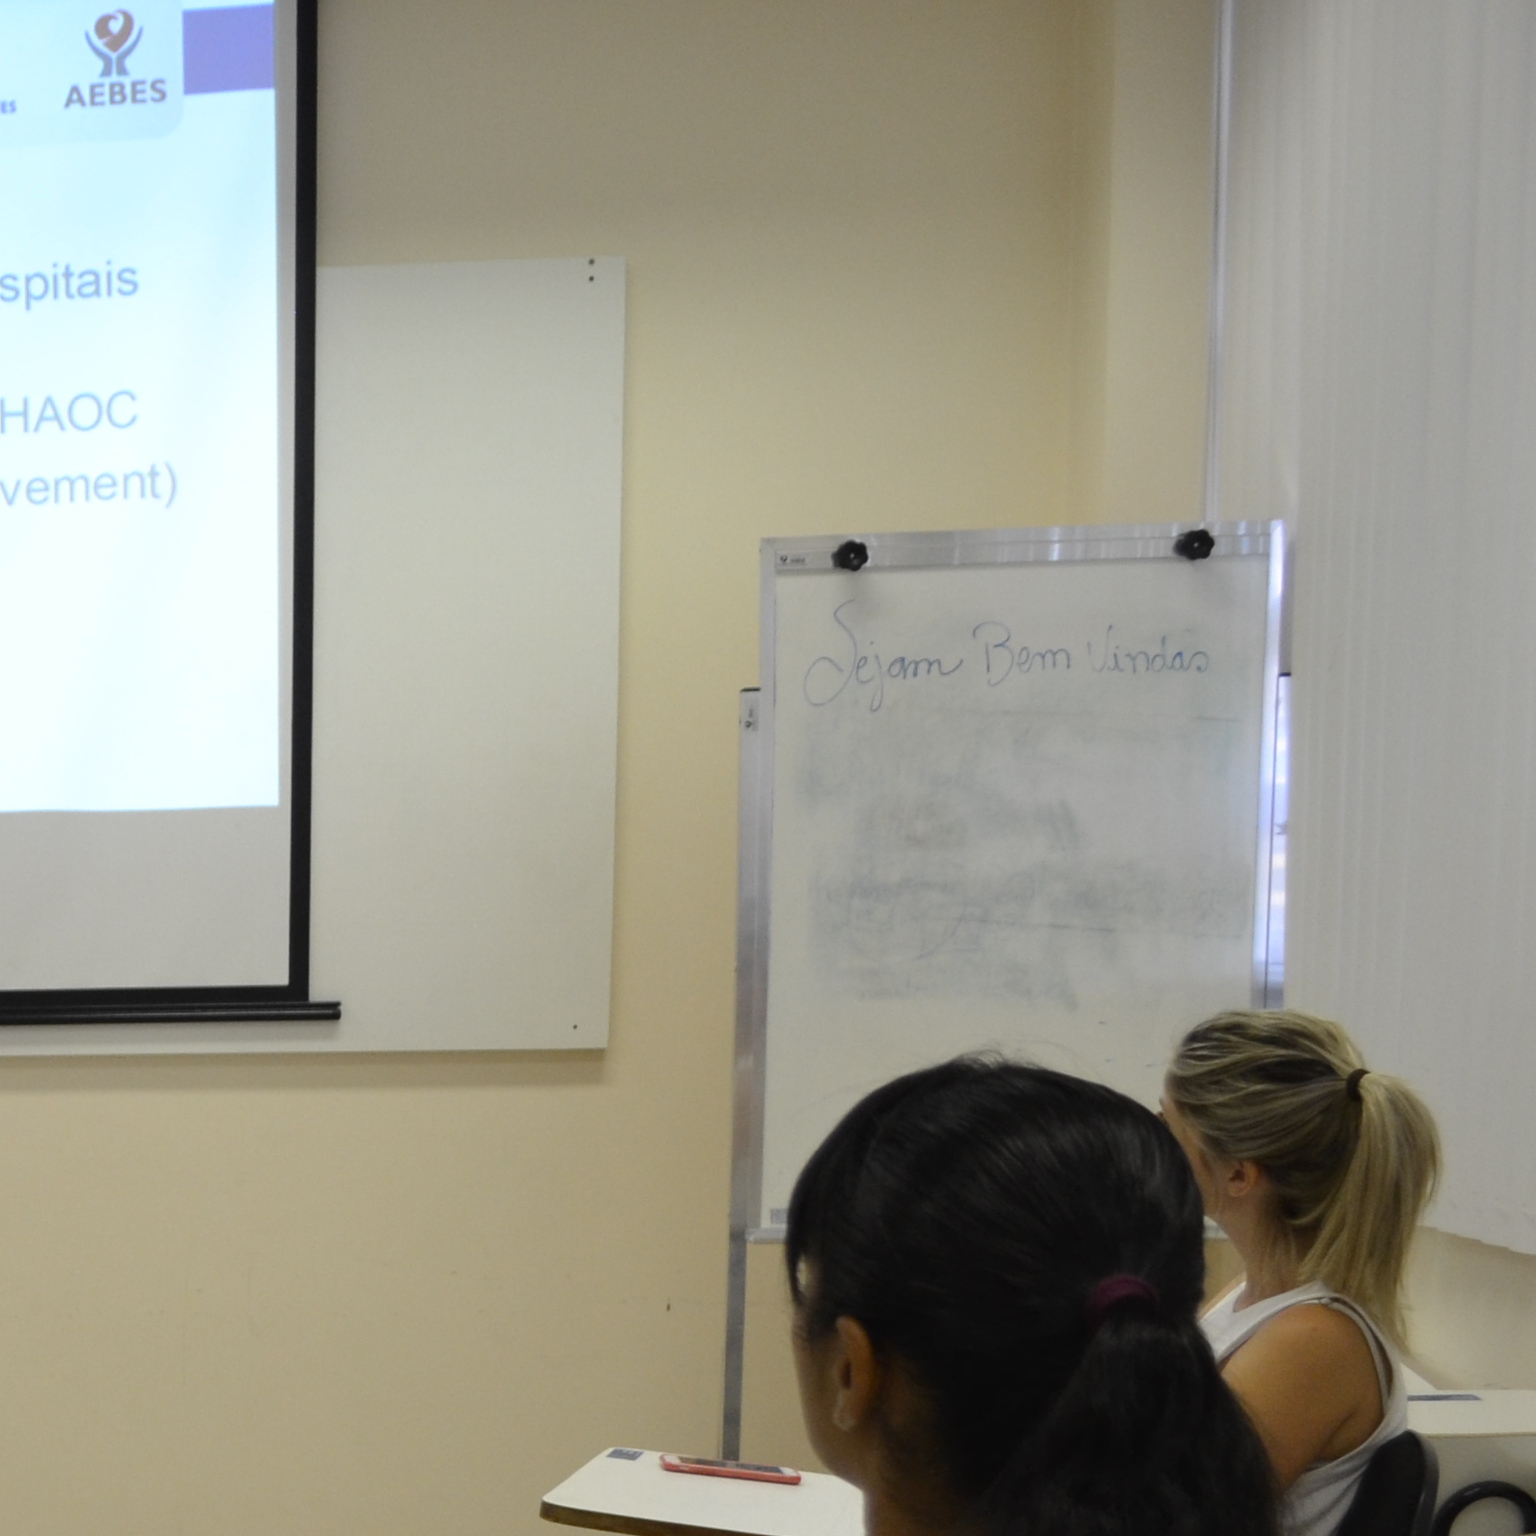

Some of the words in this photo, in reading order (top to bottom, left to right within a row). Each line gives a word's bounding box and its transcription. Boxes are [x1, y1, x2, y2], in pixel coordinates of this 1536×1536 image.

[64, 79, 167, 108] AEBES
[0, 389, 140, 434] HAOC
[803, 599, 964, 713] Sejam
[972, 621, 1071, 686] Bem
